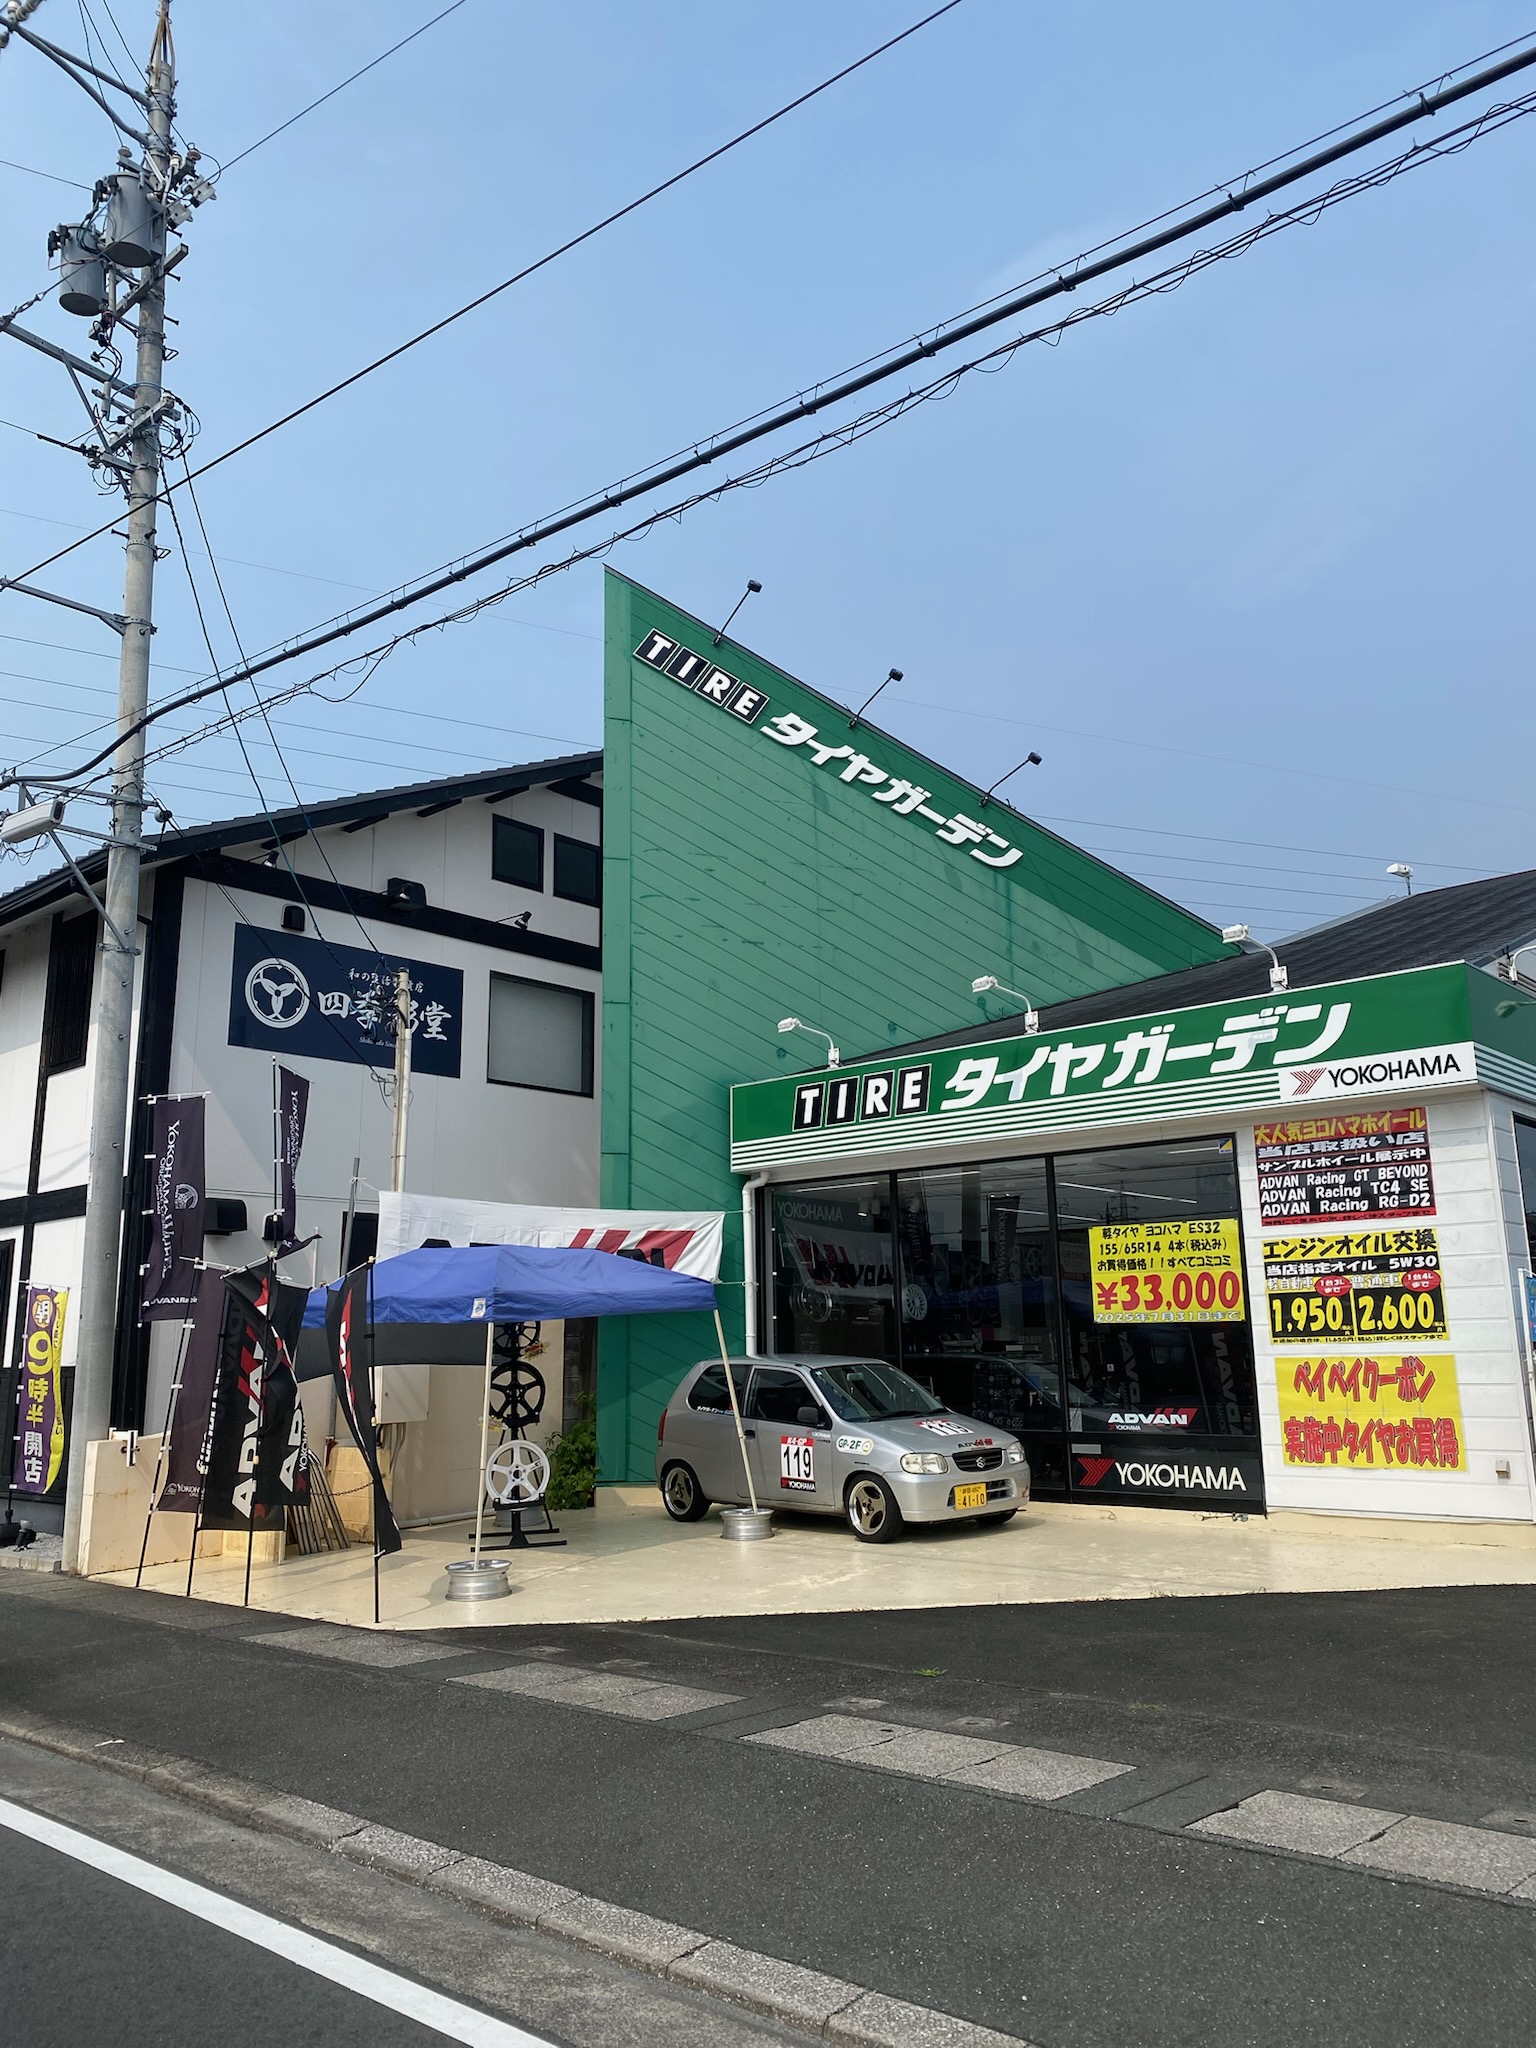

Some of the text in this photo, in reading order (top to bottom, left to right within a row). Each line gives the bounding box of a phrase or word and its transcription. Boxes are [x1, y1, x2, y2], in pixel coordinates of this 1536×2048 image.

[649, 633, 761, 716] TIRE
[760, 712, 1024, 868] タイヤガーデン
[940, 1002, 1352, 1110] タイヤガーデン
[1328, 1053, 1461, 1088] YOKOHAMA
[798, 1068, 923, 1125] TIRE
[1255, 1108, 1426, 1145] 大人気ヨコハマホイール
[1258, 1131, 1426, 1158] 当店取扱い店
[1258, 1148, 1427, 1172] サンプルホイール展示中
[1260, 1164, 1428, 1190] ADVAN Racing GT BEYOND
[1261, 1178, 1429, 1203] ADVAN Racing TC4 SE
[777, 1200, 844, 1222] YOKOHAMA
[1262, 1194, 1431, 1217] ADVAN Racing RG-D2
[1103, 1222, 1221, 1240] 軽タイヤ ヨコハマ ES32
[1100, 1238, 1227, 1256] 155/65R14 4本(税込み)
[1263, 1228, 1437, 1260] エンジンオイル交換
[1267, 1255, 1437, 1276] 当店指定オイル 5W30
[1407, 1273, 1434, 1282] 1台4L
[1095, 1271, 1241, 1311] ¥33,000
[1267, 1276, 1314, 1291] 軽自動車
[1320, 1279, 1345, 1288] 1台3L
[1323, 1286, 1341, 1294] まで
[1350, 1274, 1400, 1289] 普通車
[1411, 1280, 1430, 1288] まで
[1095, 1311, 1241, 1322] 2025年7月31日まで
[1272, 1297, 1344, 1333] 1,950
[1358, 1293, 1435, 1331] 2,600
[1293, 1356, 1436, 1402] ペイペイクーポン
[1107, 1412, 1188, 1425] ADVAN
[838, 1438, 862, 1450] GP-2F
[1284, 1416, 1459, 1468] 実施中タイヤお買得
[783, 1446, 811, 1478] 119
[788, 1480, 816, 1491] YOKOHAMA
[1115, 1461, 1247, 1491] YOKOHAMA
